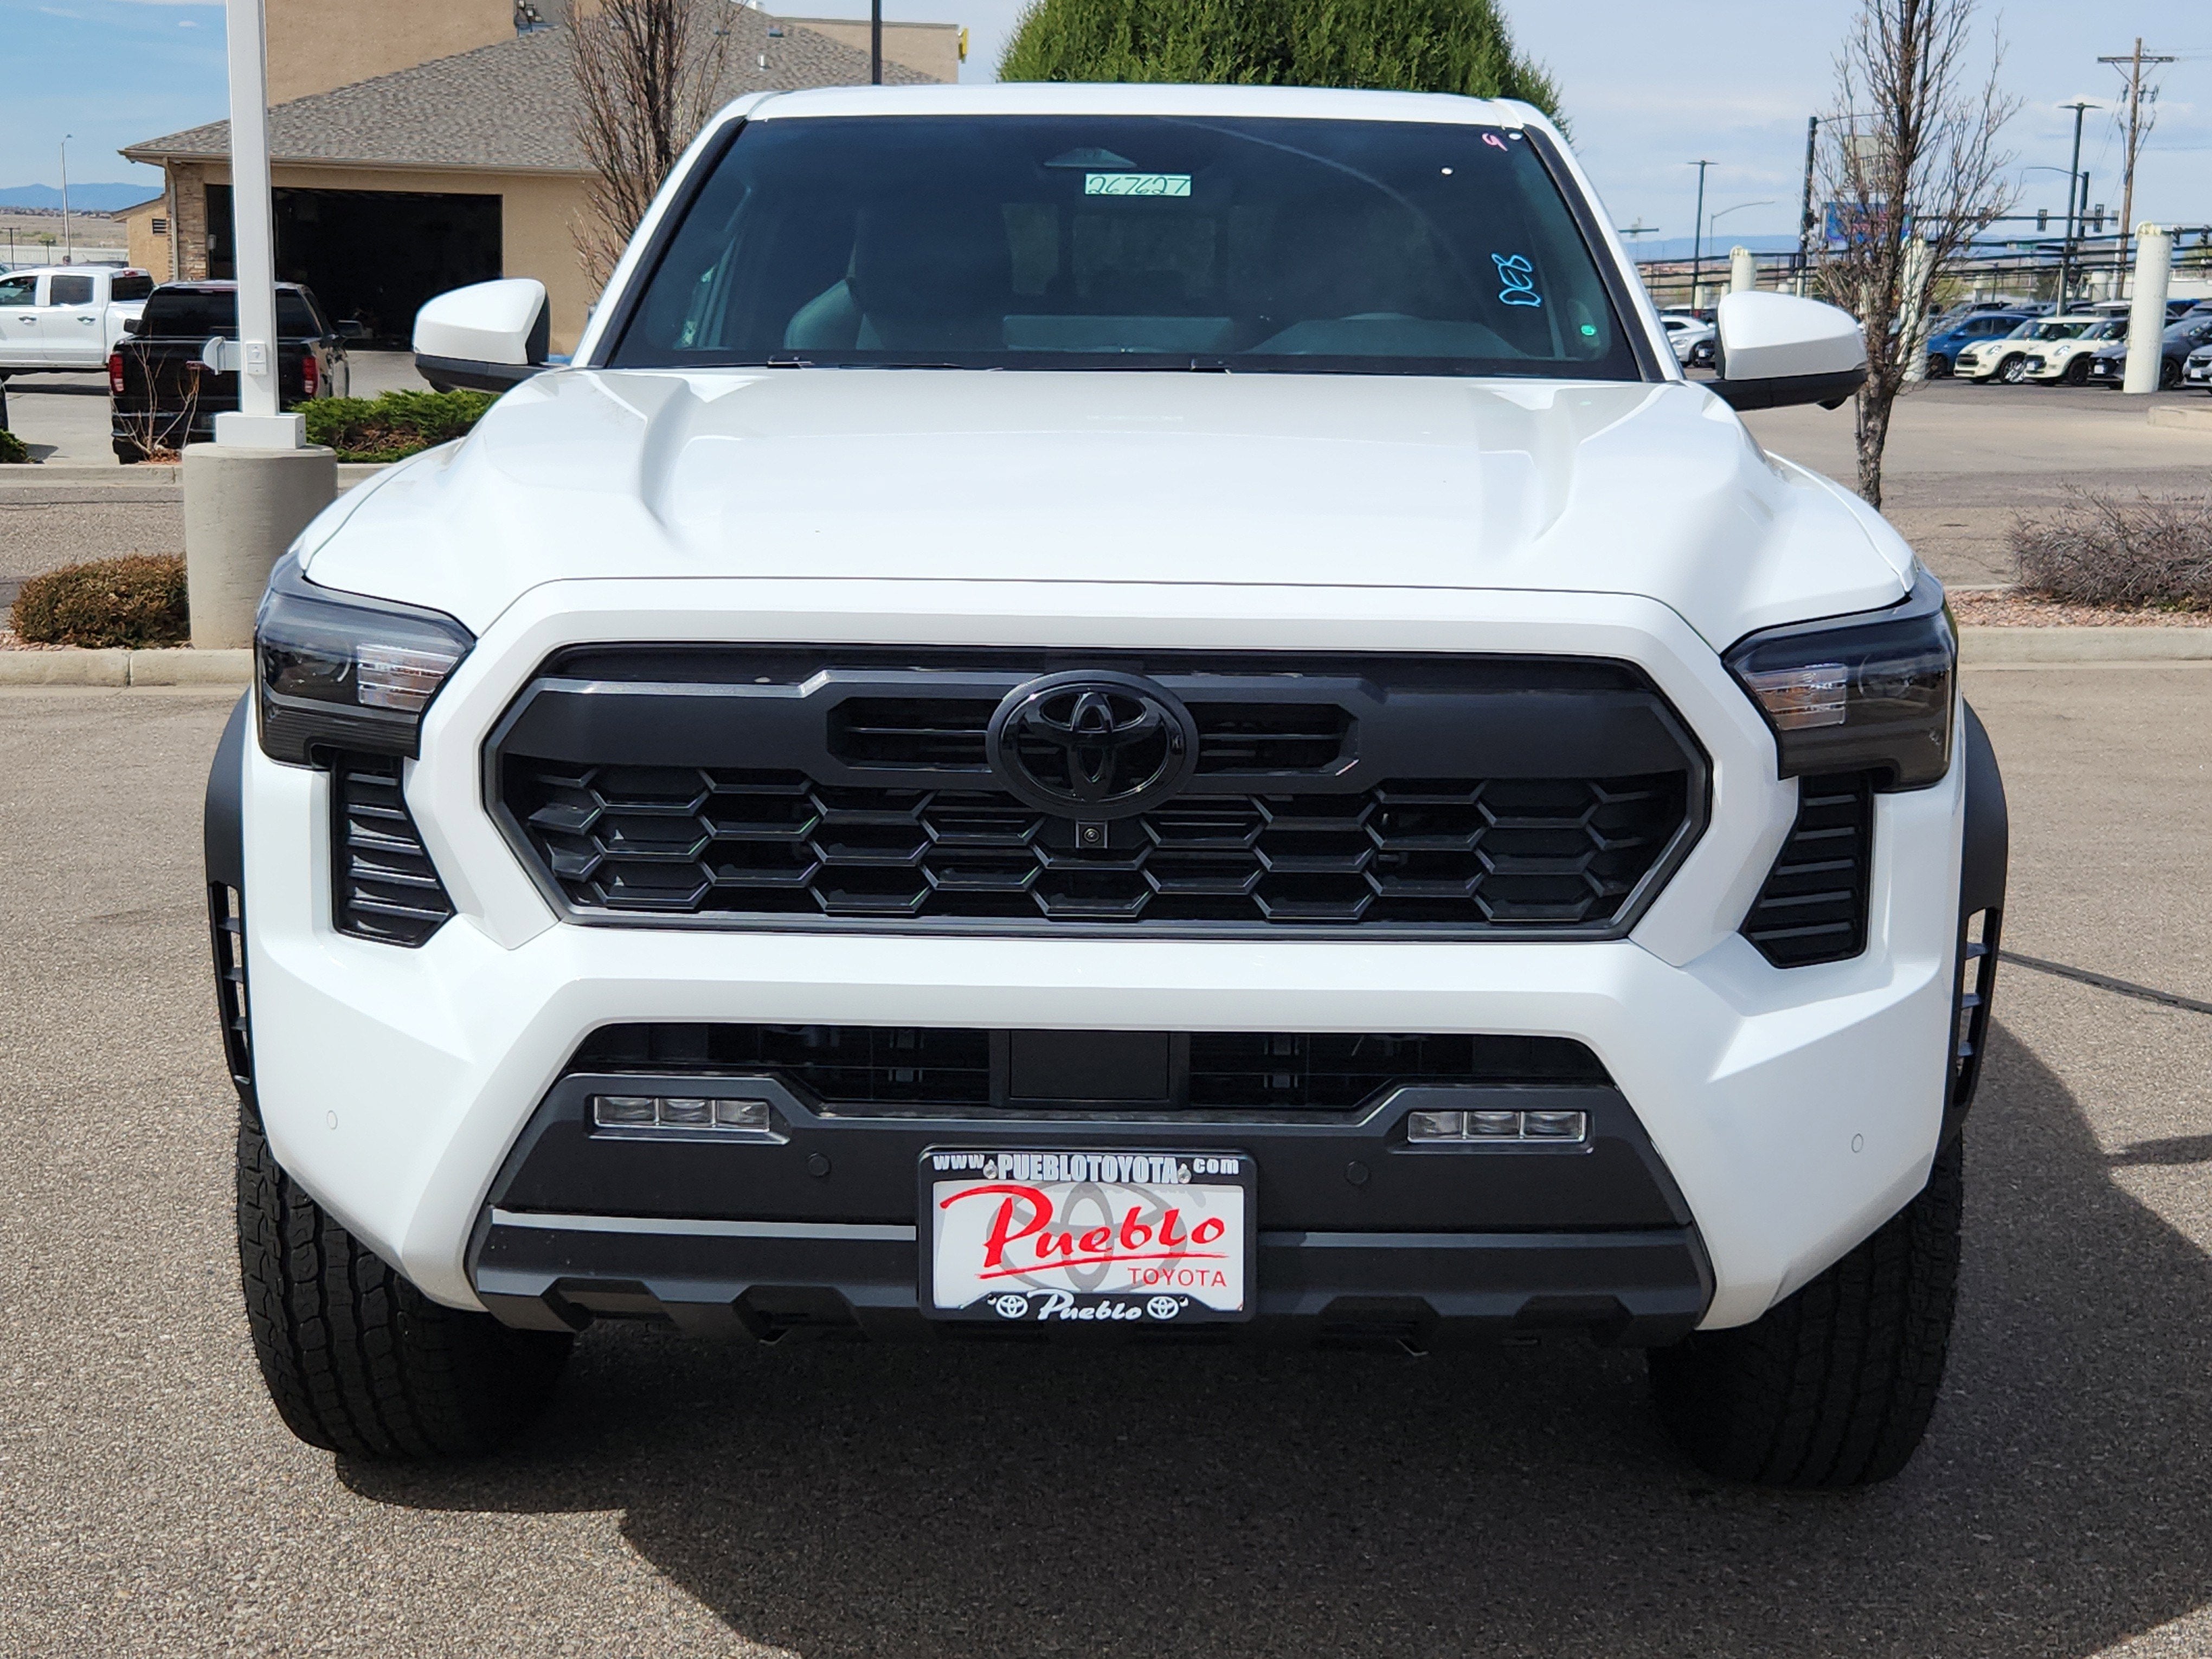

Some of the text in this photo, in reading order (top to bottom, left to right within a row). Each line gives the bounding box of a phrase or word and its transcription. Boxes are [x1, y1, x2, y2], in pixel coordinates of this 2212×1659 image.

[1088, 176, 1191, 195] 267627
[939, 1184, 1225, 1268] Pueblo
[1127, 1267, 1227, 1288] TOYOTA
[1027, 1288, 1143, 1321] Pueblo
